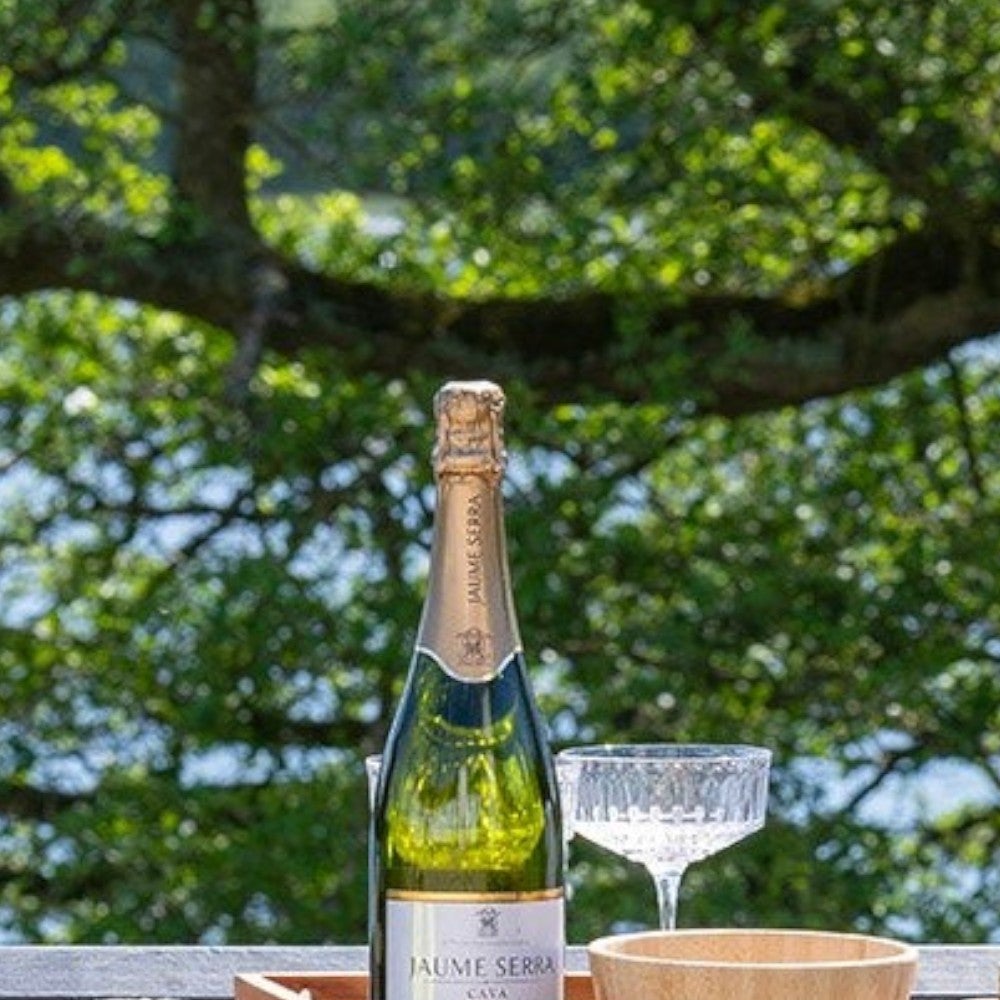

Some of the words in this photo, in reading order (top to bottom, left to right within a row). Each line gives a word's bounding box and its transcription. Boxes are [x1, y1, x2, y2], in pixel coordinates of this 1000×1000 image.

[466, 494, 483, 546] SERRA
[467, 551, 484, 606] JAUME
[410, 956, 487, 977] JAUME
[496, 955, 557, 977] SERRA
[466, 987, 508, 999] CAVA
